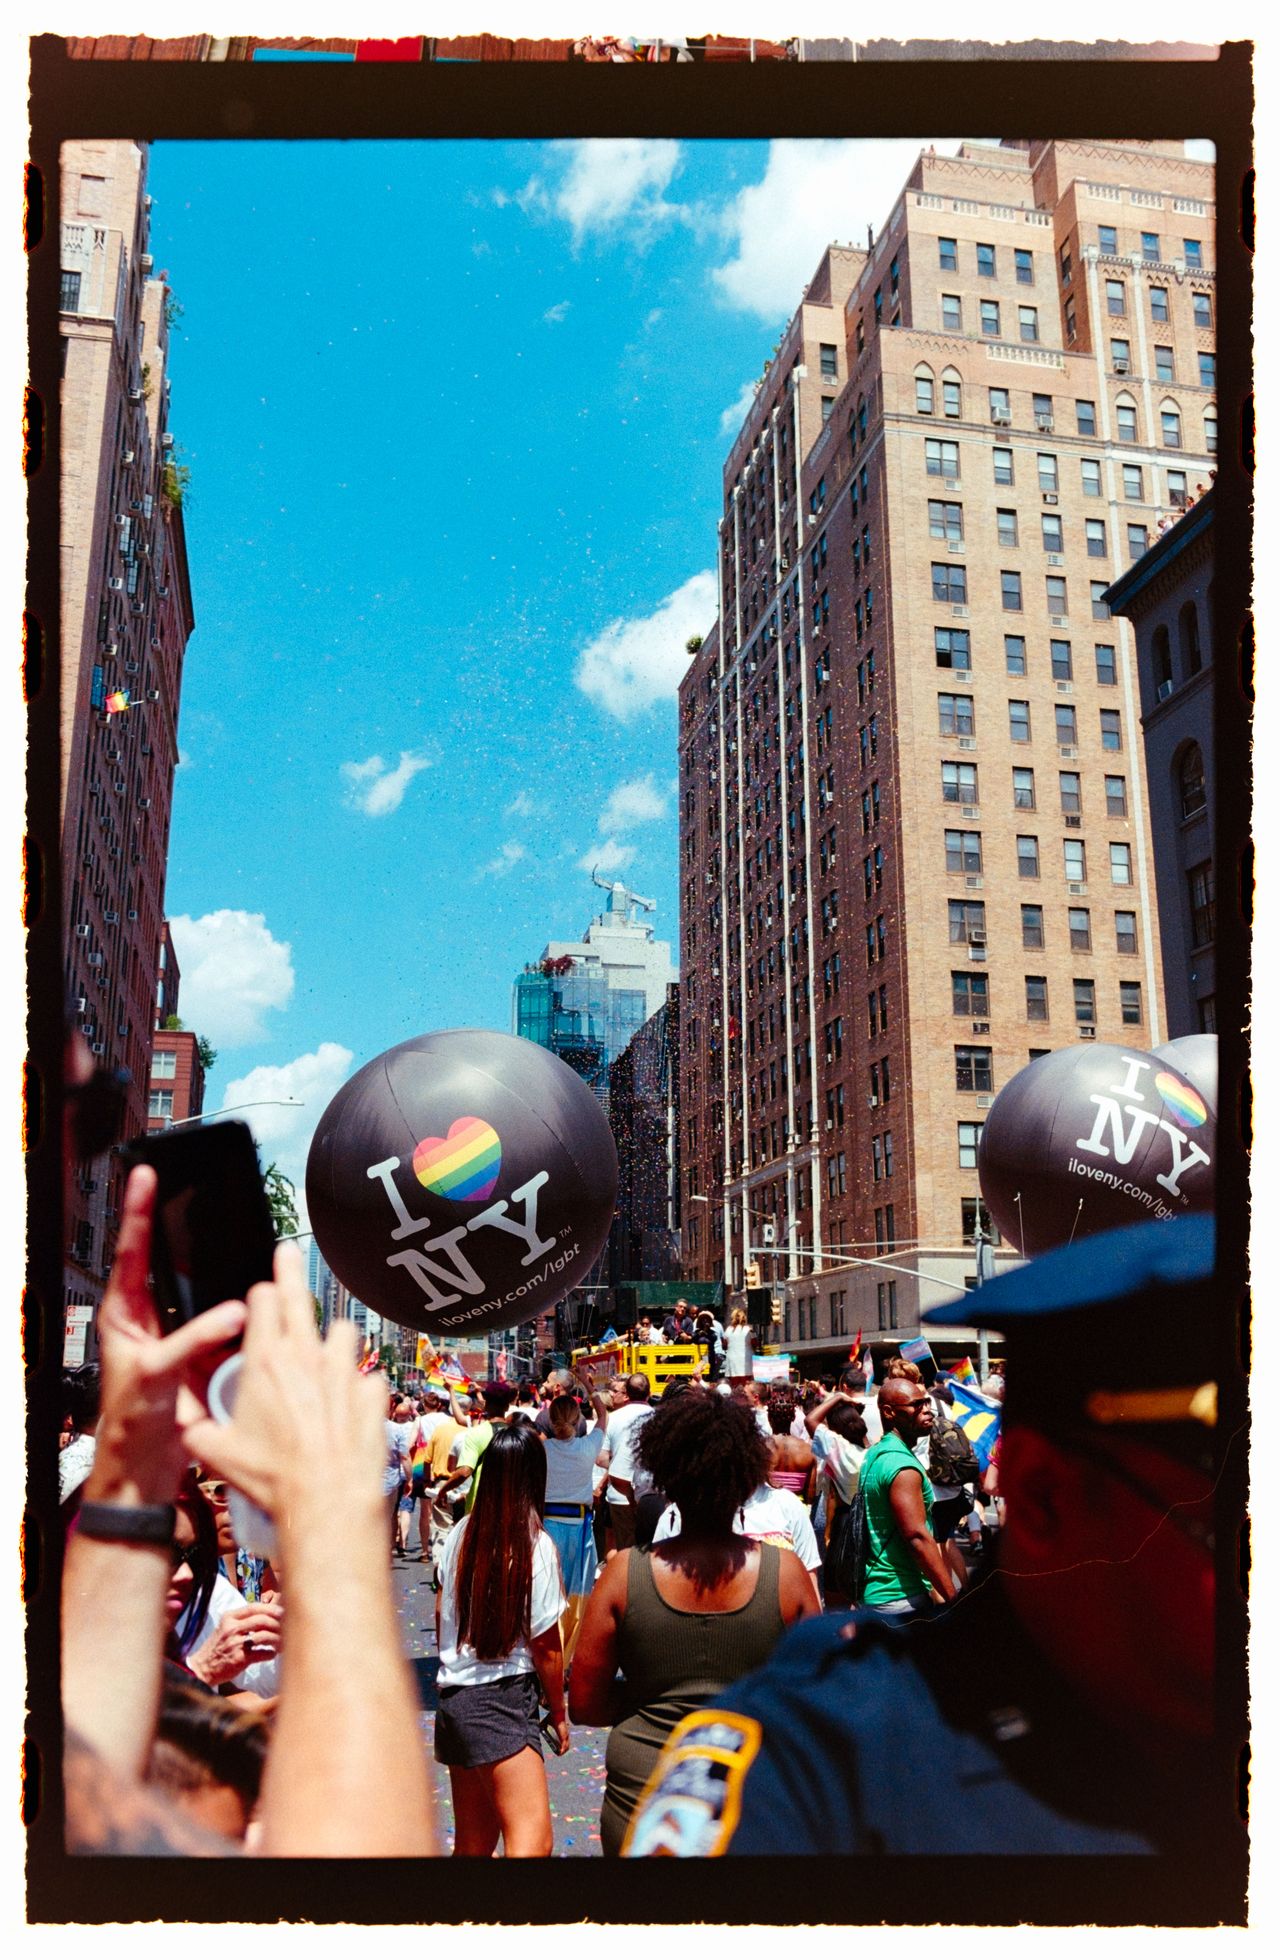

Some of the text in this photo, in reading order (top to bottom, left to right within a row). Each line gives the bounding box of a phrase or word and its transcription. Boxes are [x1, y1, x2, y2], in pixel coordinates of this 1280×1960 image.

[1110, 1056, 1150, 1102] I
[1076, 1094, 1211, 1196] NY
[366, 1156, 431, 1241] I
[386, 1170, 556, 1312] NY
[438, 1242, 580, 1327] iloveny.com/lgbt
